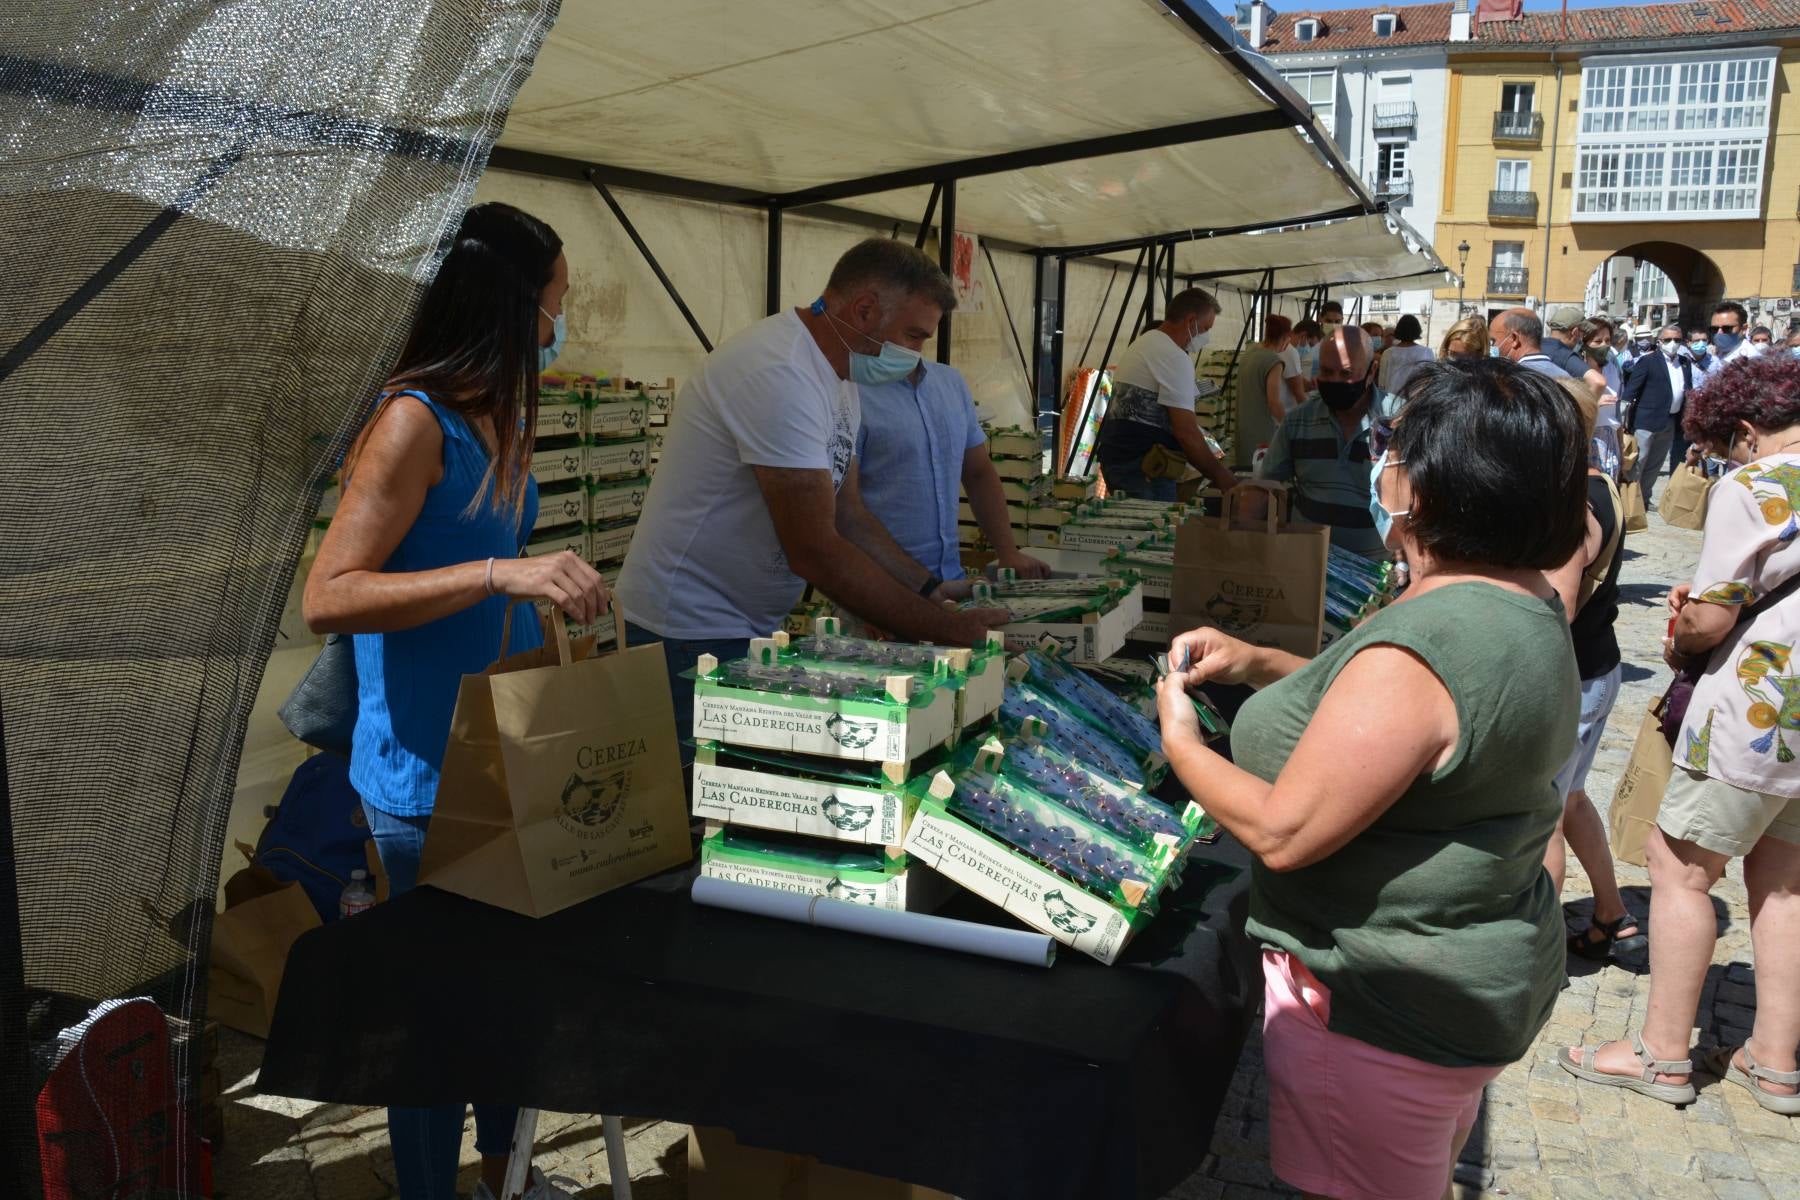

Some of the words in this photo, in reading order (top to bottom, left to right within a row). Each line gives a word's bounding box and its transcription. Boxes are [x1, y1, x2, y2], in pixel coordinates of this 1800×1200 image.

[1220, 579, 1286, 600] CEREZA
[702, 701, 724, 710] CEREZA
[729, 704, 757, 714] MANZANA
[758, 707, 783, 717] REINETA
[795, 712, 813, 720] VALLE
[703, 708, 728, 724] LAS
[732, 712, 822, 735] CADERECHAS
[576, 737, 648, 770] CEREZA
[701, 779, 721, 789] CEREZA
[727, 783, 755, 793] MANZANA
[755, 787, 779, 797] REINETA
[791, 792, 809, 801] VALLE
[702, 786, 725, 802] LAS
[729, 791, 818, 816] CADERECHAS
[918, 825, 944, 850] LAS
[947, 843, 1039, 903] CADERECHAS
[922, 819, 944, 835] CEREZA
[949, 833, 977, 855] MANZANA
[978, 849, 1003, 869] REINETA
[1016, 871, 1033, 886] VALLE
[707, 859, 728, 869] CEREZA
[733, 864, 760, 874] MANZANA
[760, 868, 785, 878] REINETA
[796, 873, 813, 883] VALLE
